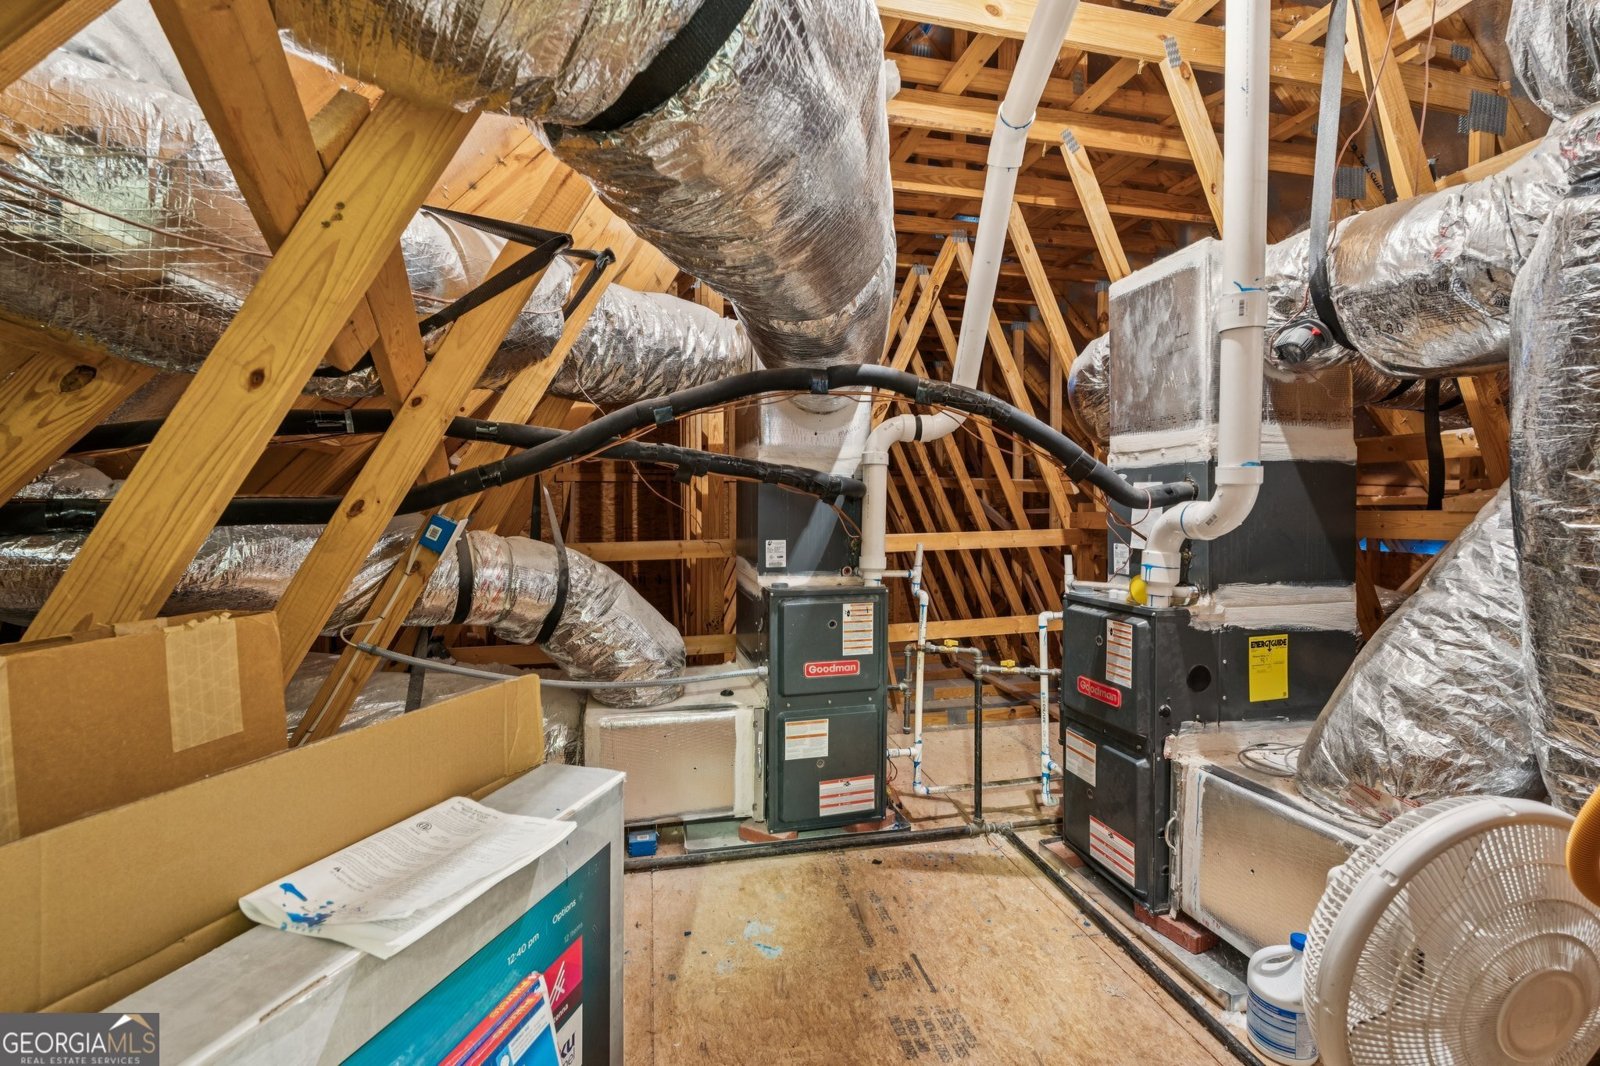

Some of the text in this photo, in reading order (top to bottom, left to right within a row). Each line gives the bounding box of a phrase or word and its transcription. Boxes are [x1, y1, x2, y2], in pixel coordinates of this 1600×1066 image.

[808, 664, 857, 674] Goodman
[1080, 680, 1118, 702] Goodman
[507, 899, 577, 966] 12:40 pm Options
